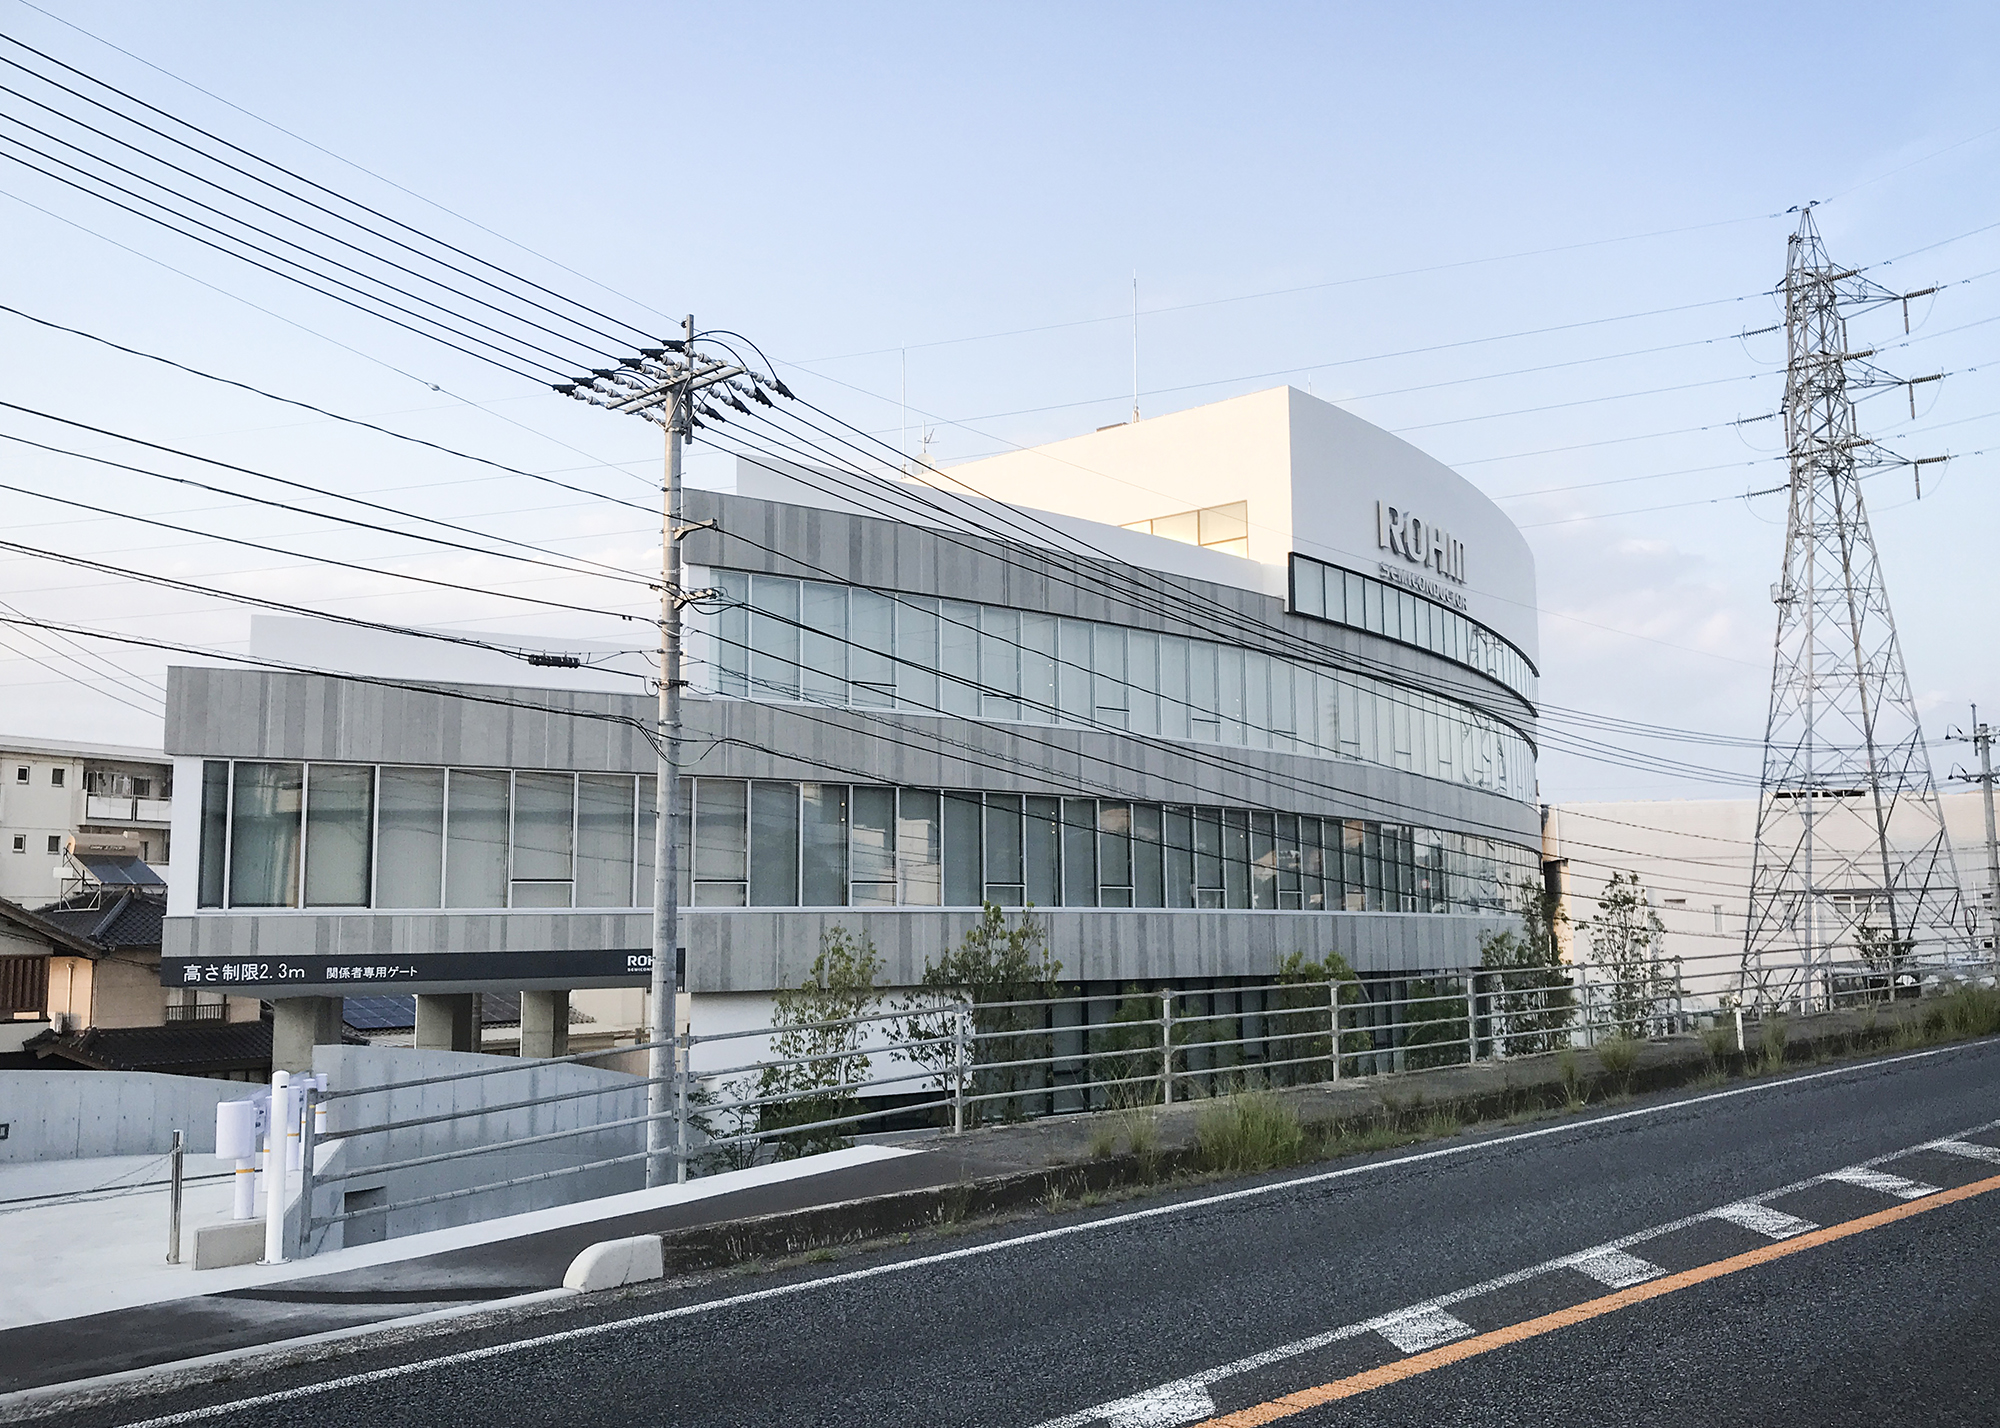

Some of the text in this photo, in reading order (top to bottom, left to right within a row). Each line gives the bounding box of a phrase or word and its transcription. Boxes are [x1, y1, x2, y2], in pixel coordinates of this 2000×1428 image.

[1379, 562, 1468, 611] SEMICONDUCTOR
[627, 955, 654, 967] ROH
[183, 963, 305, 982] 高さ制限2.3m
[326, 966, 418, 979] 関係者専用ゲート
